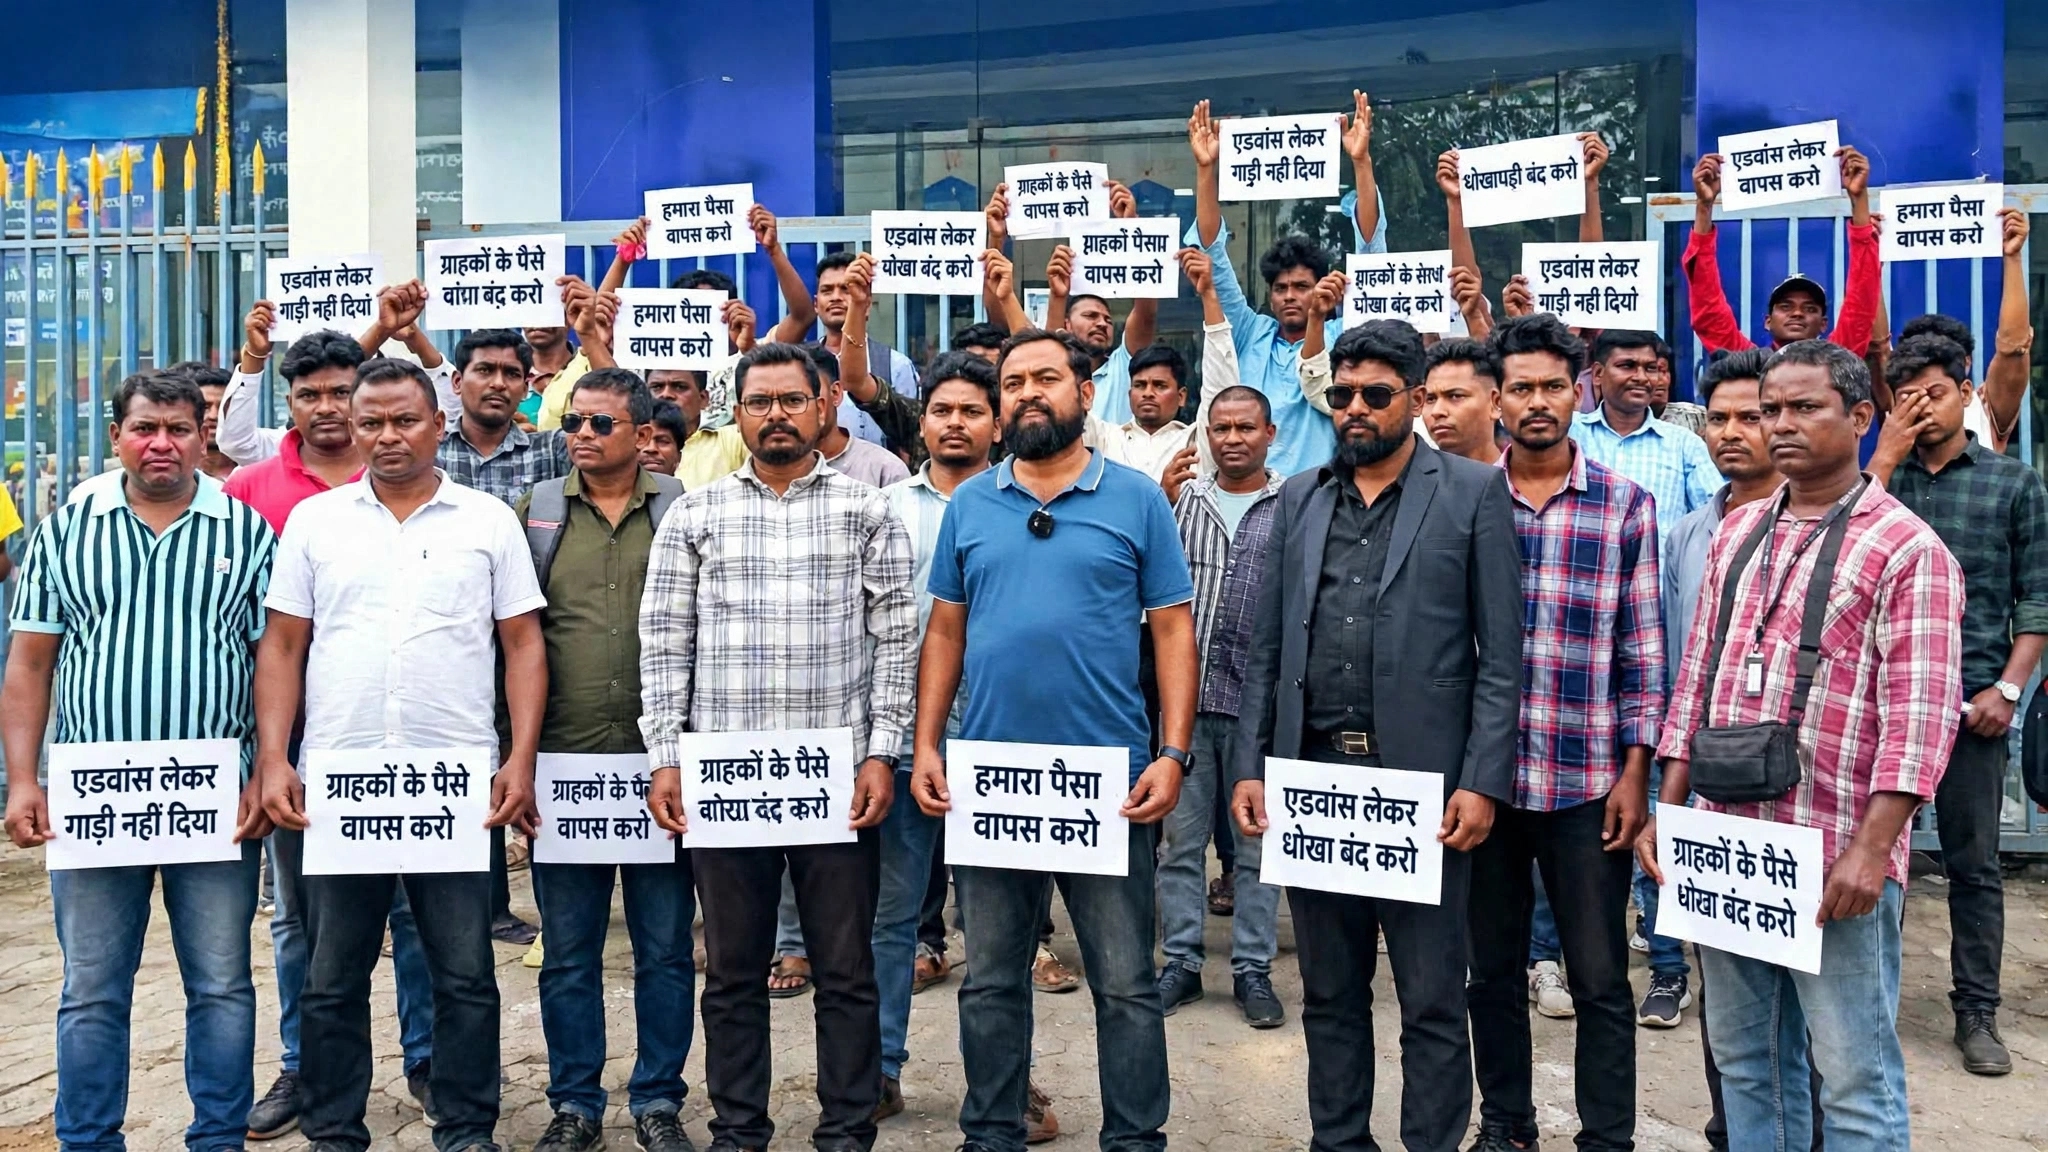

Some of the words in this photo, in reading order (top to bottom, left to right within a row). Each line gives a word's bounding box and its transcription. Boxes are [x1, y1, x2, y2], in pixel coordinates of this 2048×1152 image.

[1232, 127, 1285, 154] एडवांस
[1287, 124, 1327, 148] लेकर
[1293, 155, 1326, 181] दिया
[1731, 143, 1784, 171] एडवांस
[1787, 139, 1826, 160] लेकर
[1056, 172, 1069, 191] के
[1071, 169, 1092, 190] पैसे
[1525, 162, 1547, 185] बंद
[1550, 156, 1578, 181] करो
[1738, 174, 1783, 194] वापस
[1787, 164, 1820, 188] करो
[662, 201, 700, 221] हमारा
[704, 194, 734, 215] पैसा
[1023, 203, 1060, 219] वापस
[1063, 195, 1089, 217] करो
[1896, 202, 1945, 224] हमारा
[1949, 194, 1985, 217] पैसा
[666, 228, 702, 244] वापस
[705, 220, 732, 242] करो
[940, 222, 976, 246] लेकर
[1896, 229, 1945, 247] वापस
[1949, 221, 1984, 245] करो
[440, 246, 491, 276] ग्राहकों
[494, 247, 513, 272] के
[515, 244, 546, 271] पैसे
[945, 254, 974, 278] करो
[1084, 266, 1127, 283] वापस
[1131, 259, 1163, 284] करो
[1398, 263, 1413, 284] के
[1539, 254, 1595, 283] एडवांस
[1598, 253, 1640, 278] लेकर
[280, 265, 332, 294] एडवांस
[334, 263, 373, 287] लेकर
[510, 278, 544, 304] करो
[279, 295, 310, 324] गाड़ी
[633, 305, 677, 327] हमारा
[680, 298, 712, 324] पैसा
[1415, 289, 1444, 313] करो
[629, 337, 675, 357] वापस
[679, 331, 713, 357] करो
[71, 759, 154, 799] एडवांस
[159, 757, 219, 791] लेकर
[699, 749, 763, 785] ग्राहकों
[768, 748, 791, 780] के
[795, 746, 830, 779] पैसे
[974, 765, 1043, 797] हमारा
[1049, 758, 1102, 799] पैसा
[326, 764, 398, 802] ग्राहकों
[402, 763, 427, 797] के
[431, 761, 470, 797] पैसे
[552, 772, 606, 805] ग्राहकों
[609, 773, 628, 801] के
[1283, 784, 1358, 820] एडवांस
[1363, 787, 1419, 827] लेकर
[64, 804, 116, 846] गाड़ी
[121, 802, 163, 841] नहीं
[167, 801, 218, 838] दिया
[340, 816, 405, 840] वापस
[409, 805, 455, 840] करो
[557, 817, 609, 840] वापस
[613, 809, 651, 840] करो
[973, 812, 1043, 843] वापस
[1049, 808, 1100, 847] करो
[1283, 824, 1335, 864] धोखा
[1340, 832, 1371, 872] बंद
[1375, 837, 1419, 874] करो
[1672, 836, 1731, 875] ग्राहकों
[1735, 840, 1757, 879] के
[1761, 843, 1798, 889] पैसे
[1678, 877, 1719, 919] धोखा
[1722, 887, 1751, 931] बंद
[1755, 898, 1797, 938] करो
